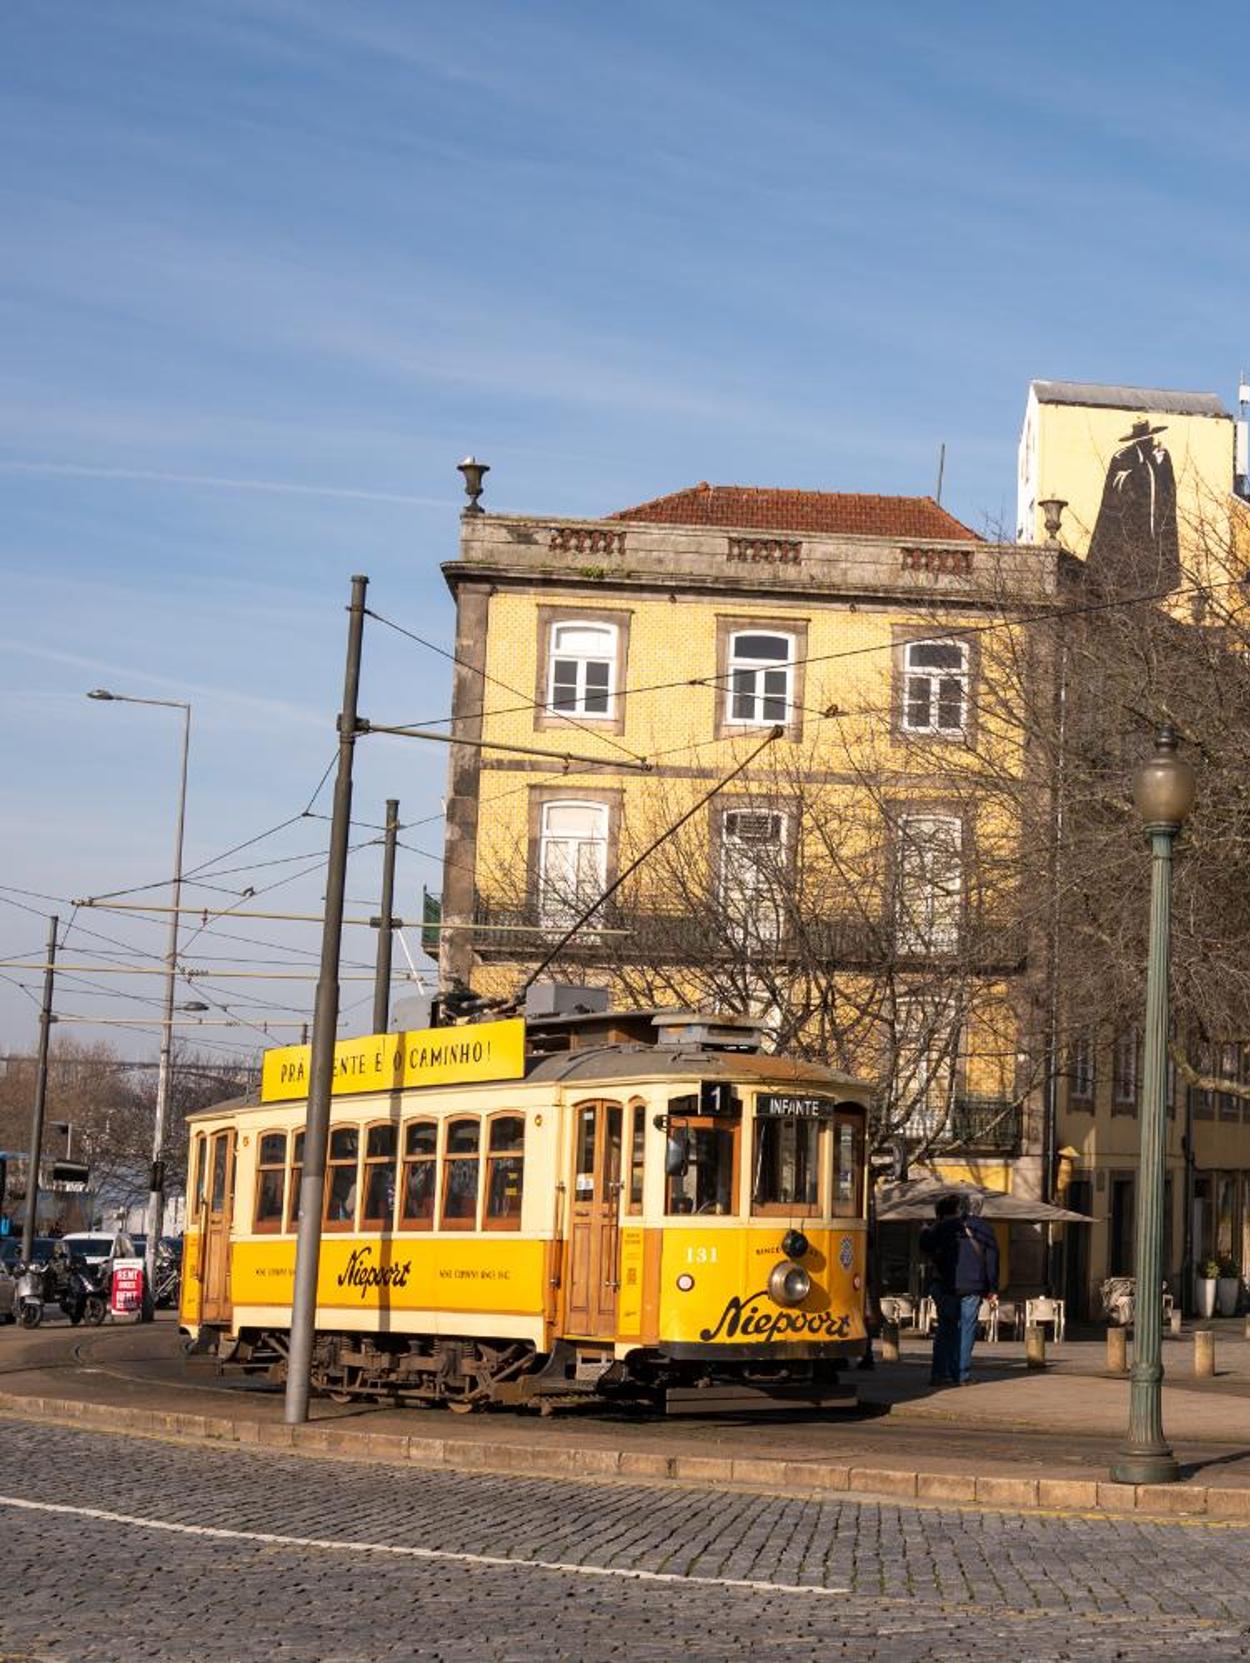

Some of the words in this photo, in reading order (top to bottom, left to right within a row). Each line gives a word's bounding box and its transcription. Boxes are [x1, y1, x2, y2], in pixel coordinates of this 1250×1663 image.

[281, 1057, 304, 1083] PRÁ
[375, 1046, 382, 1072] É
[393, 1050, 402, 1072] O
[410, 1041, 491, 1069] CAMINHO!
[710, 1085, 721, 1111] 1
[769, 1098, 820, 1116] INFANTE
[686, 1246, 719, 1264] 131
[337, 1246, 412, 1299] Niepoort
[700, 1290, 850, 1342] Niepoort
